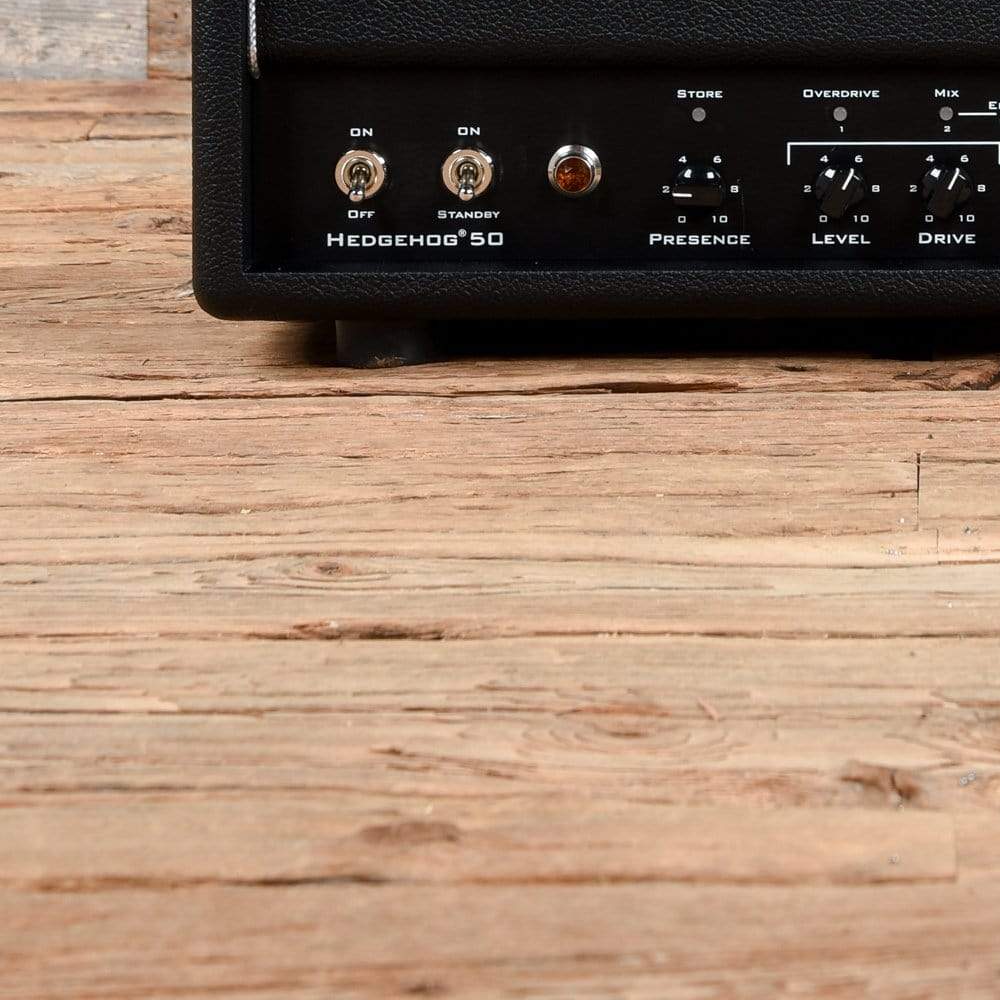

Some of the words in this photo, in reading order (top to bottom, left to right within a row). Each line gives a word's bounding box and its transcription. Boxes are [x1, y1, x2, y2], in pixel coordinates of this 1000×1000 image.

[676, 89, 723, 99] STORE
[802, 88, 880, 98] OVERDRIVE
[934, 88, 960, 98] MIX
[350, 127, 373, 137] ON
[457, 126, 481, 136] ON
[678, 155, 688, 164] 4
[713, 155, 722, 164] 6
[819, 154, 829, 163] 4
[854, 154, 864, 163] 6
[925, 154, 935, 163] 4
[960, 154, 969, 163] 6
[662, 185, 671, 194] 2
[730, 185, 739, 194] 8
[803, 184, 812, 193] 2
[871, 184, 881, 193] 8
[909, 184, 918, 193] 2
[977, 184, 986, 193] 8
[347, 209, 376, 219] OFF
[437, 210, 500, 219] STANDBY
[853, 214, 870, 223] 10
[958, 214, 975, 223] 10
[711, 215, 728, 224] 10
[470, 231, 504, 246] 50
[649, 233, 751, 246] PRESENCE
[811, 232, 871, 245] LEVEL
[918, 232, 976, 245] DRIVE
